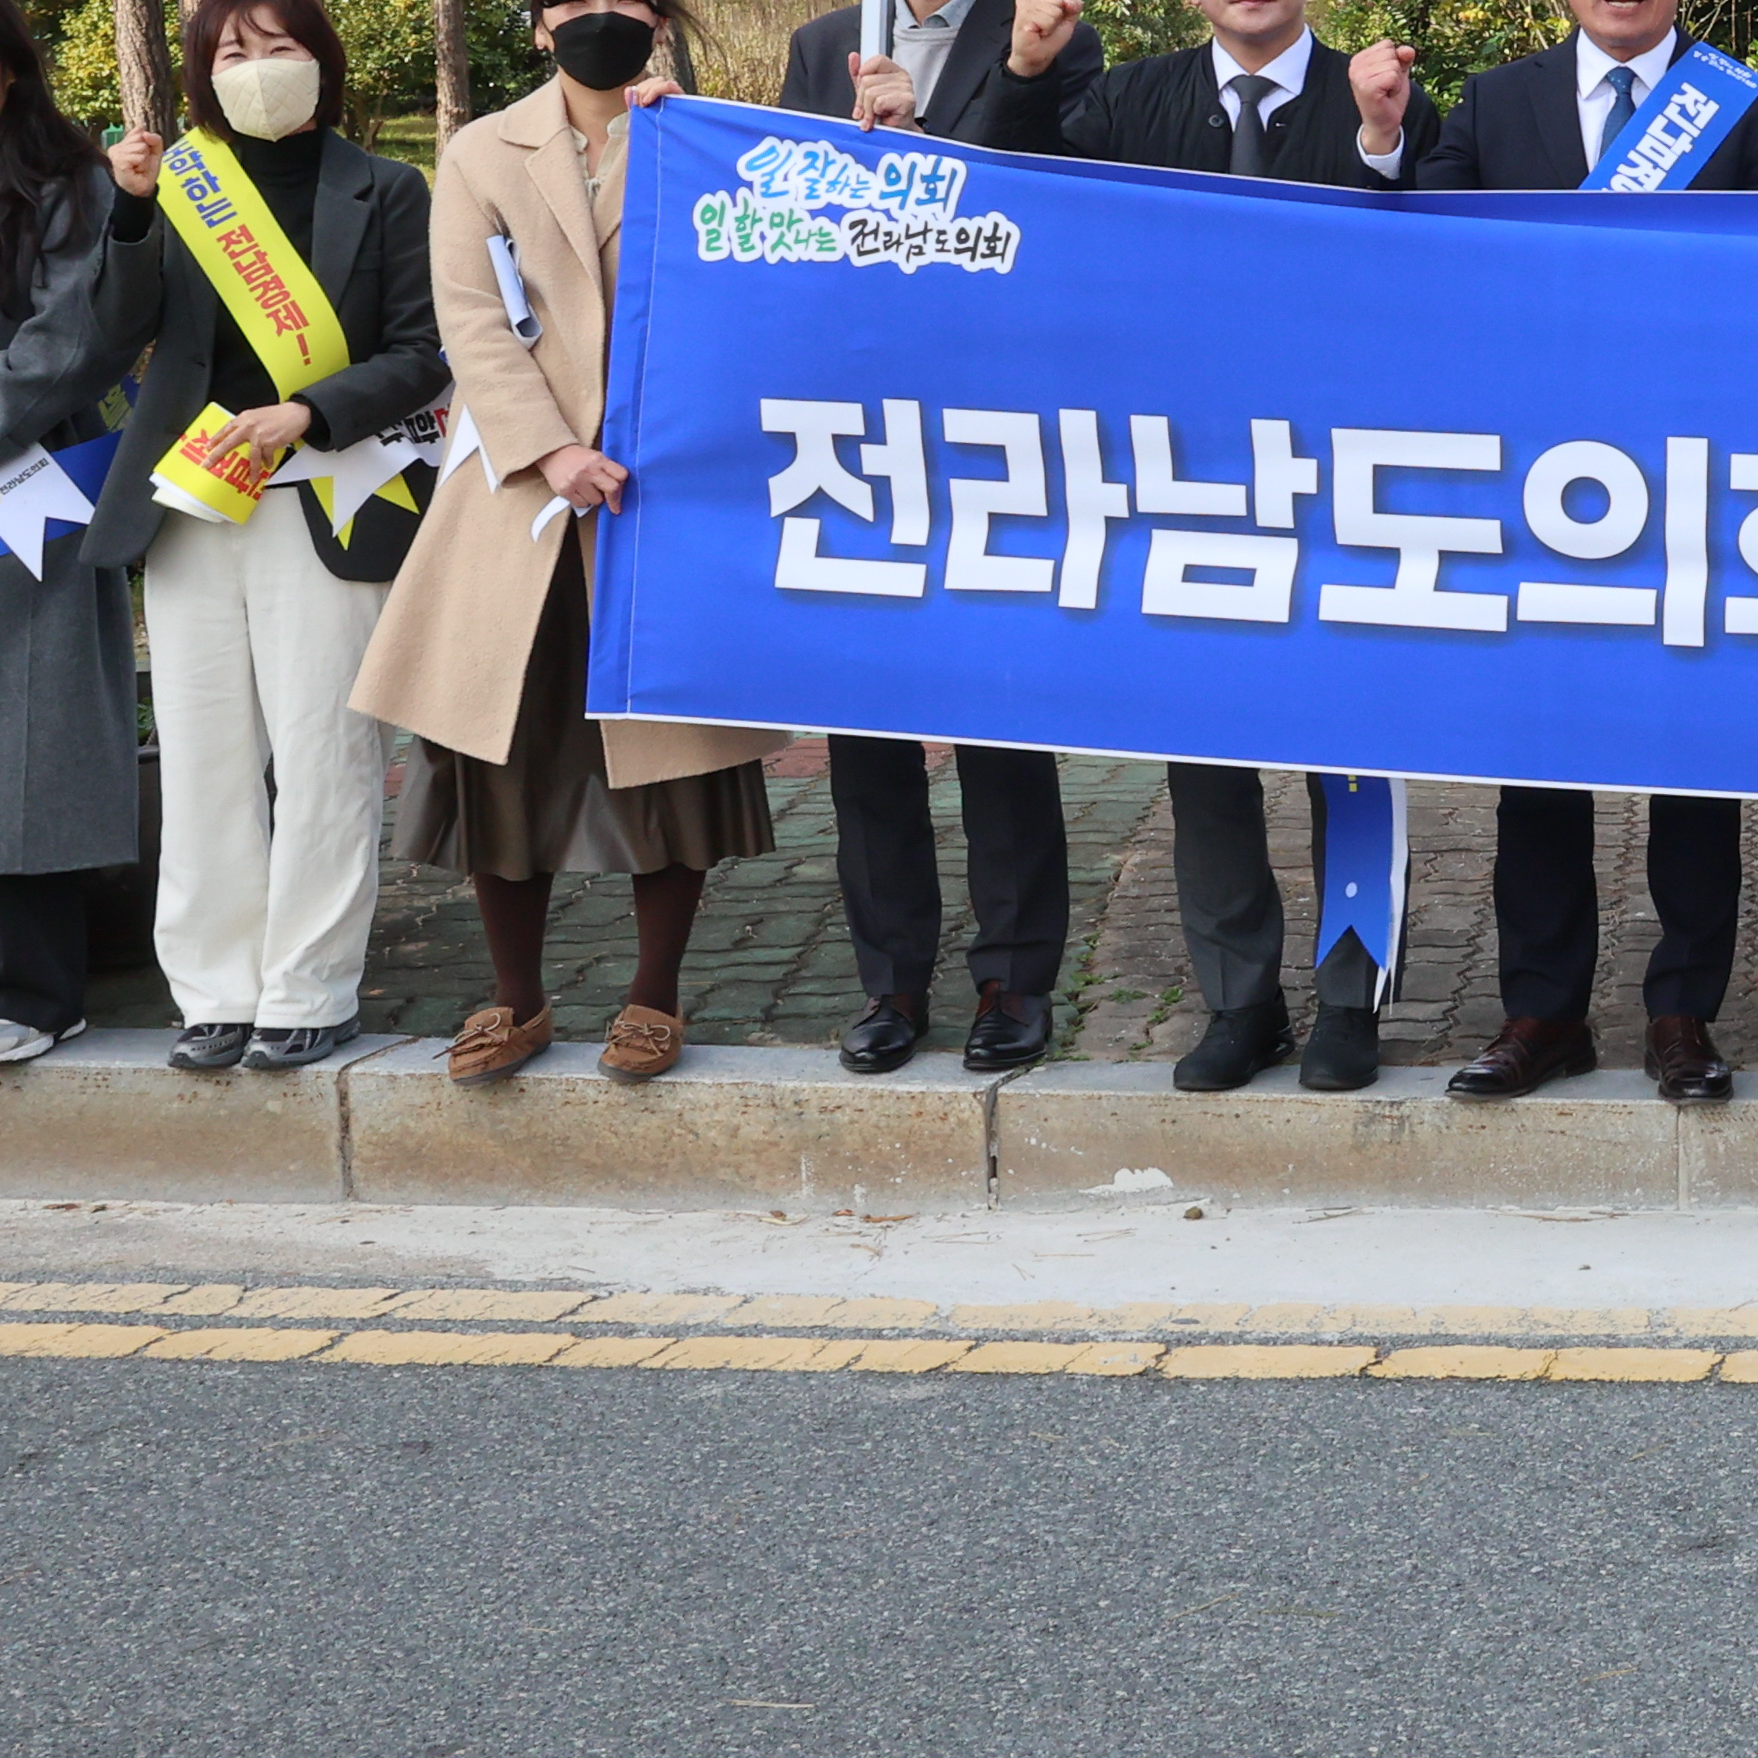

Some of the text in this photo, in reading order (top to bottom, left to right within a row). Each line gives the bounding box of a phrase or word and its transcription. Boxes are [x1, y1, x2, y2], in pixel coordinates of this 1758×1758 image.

[745, 144, 958, 213] 일 잘하는 의회
[849, 216, 1013, 265] 전라남도의회
